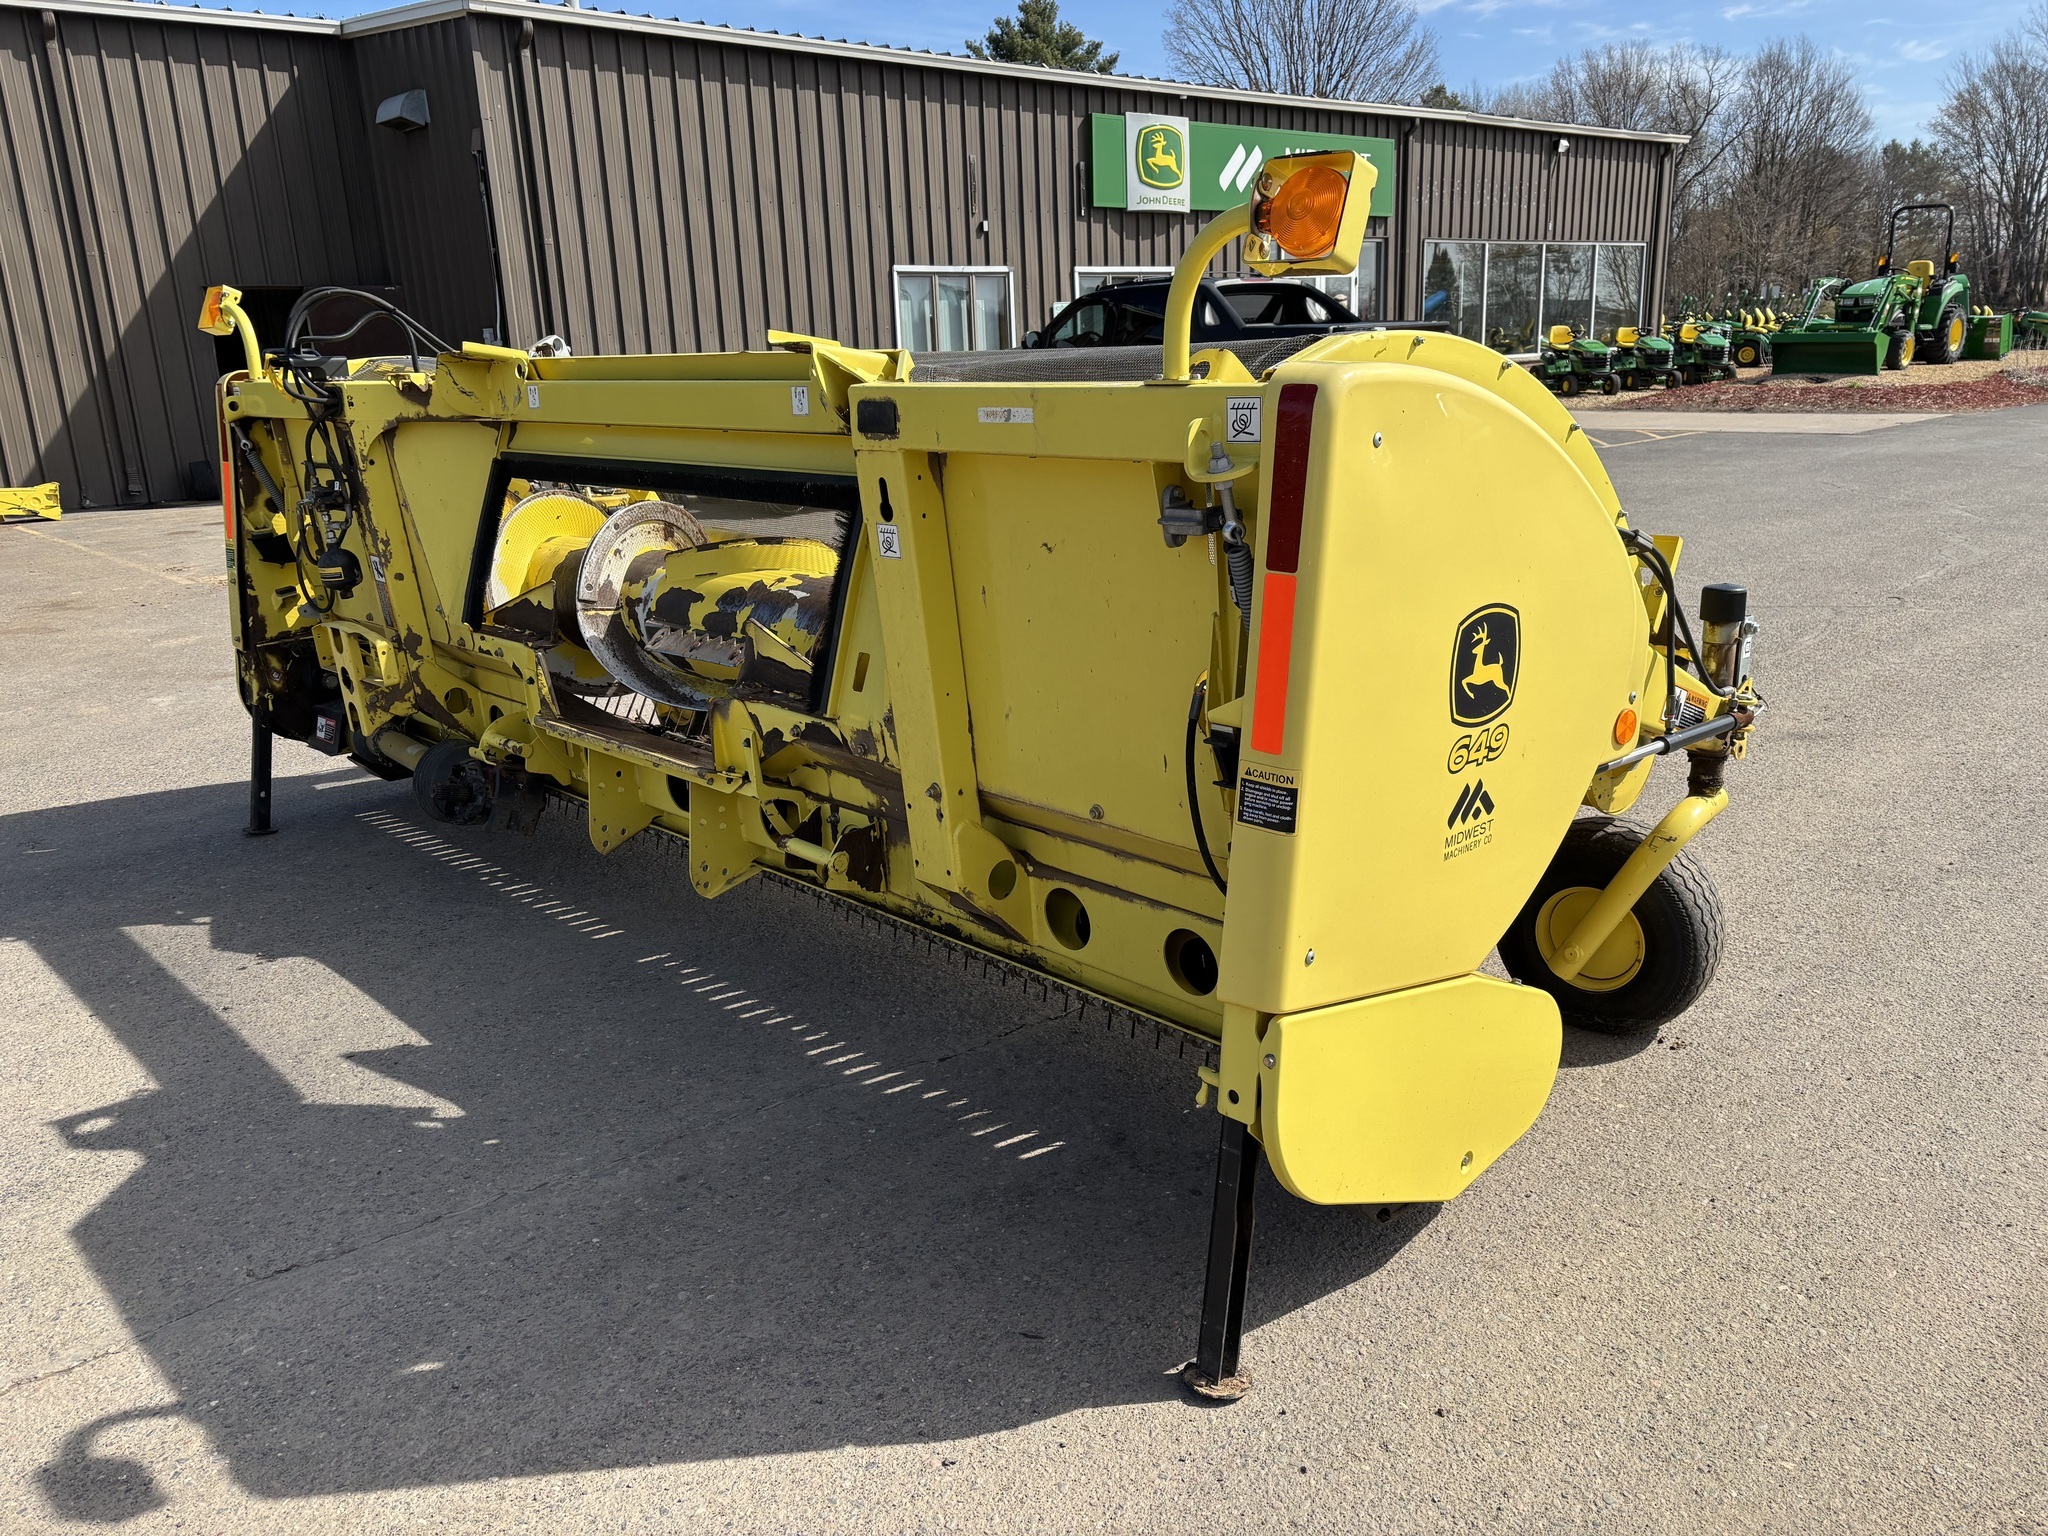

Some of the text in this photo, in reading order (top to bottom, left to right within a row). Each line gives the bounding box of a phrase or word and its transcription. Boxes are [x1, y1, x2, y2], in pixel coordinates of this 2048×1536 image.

[1692, 695, 1708, 708] WARNING
[1447, 723, 1510, 774] 649
[1252, 769, 1294, 785] CAUTION
[1443, 834, 1492, 862] MACHINERY CO
[1445, 819, 1494, 849] MIDWEST
